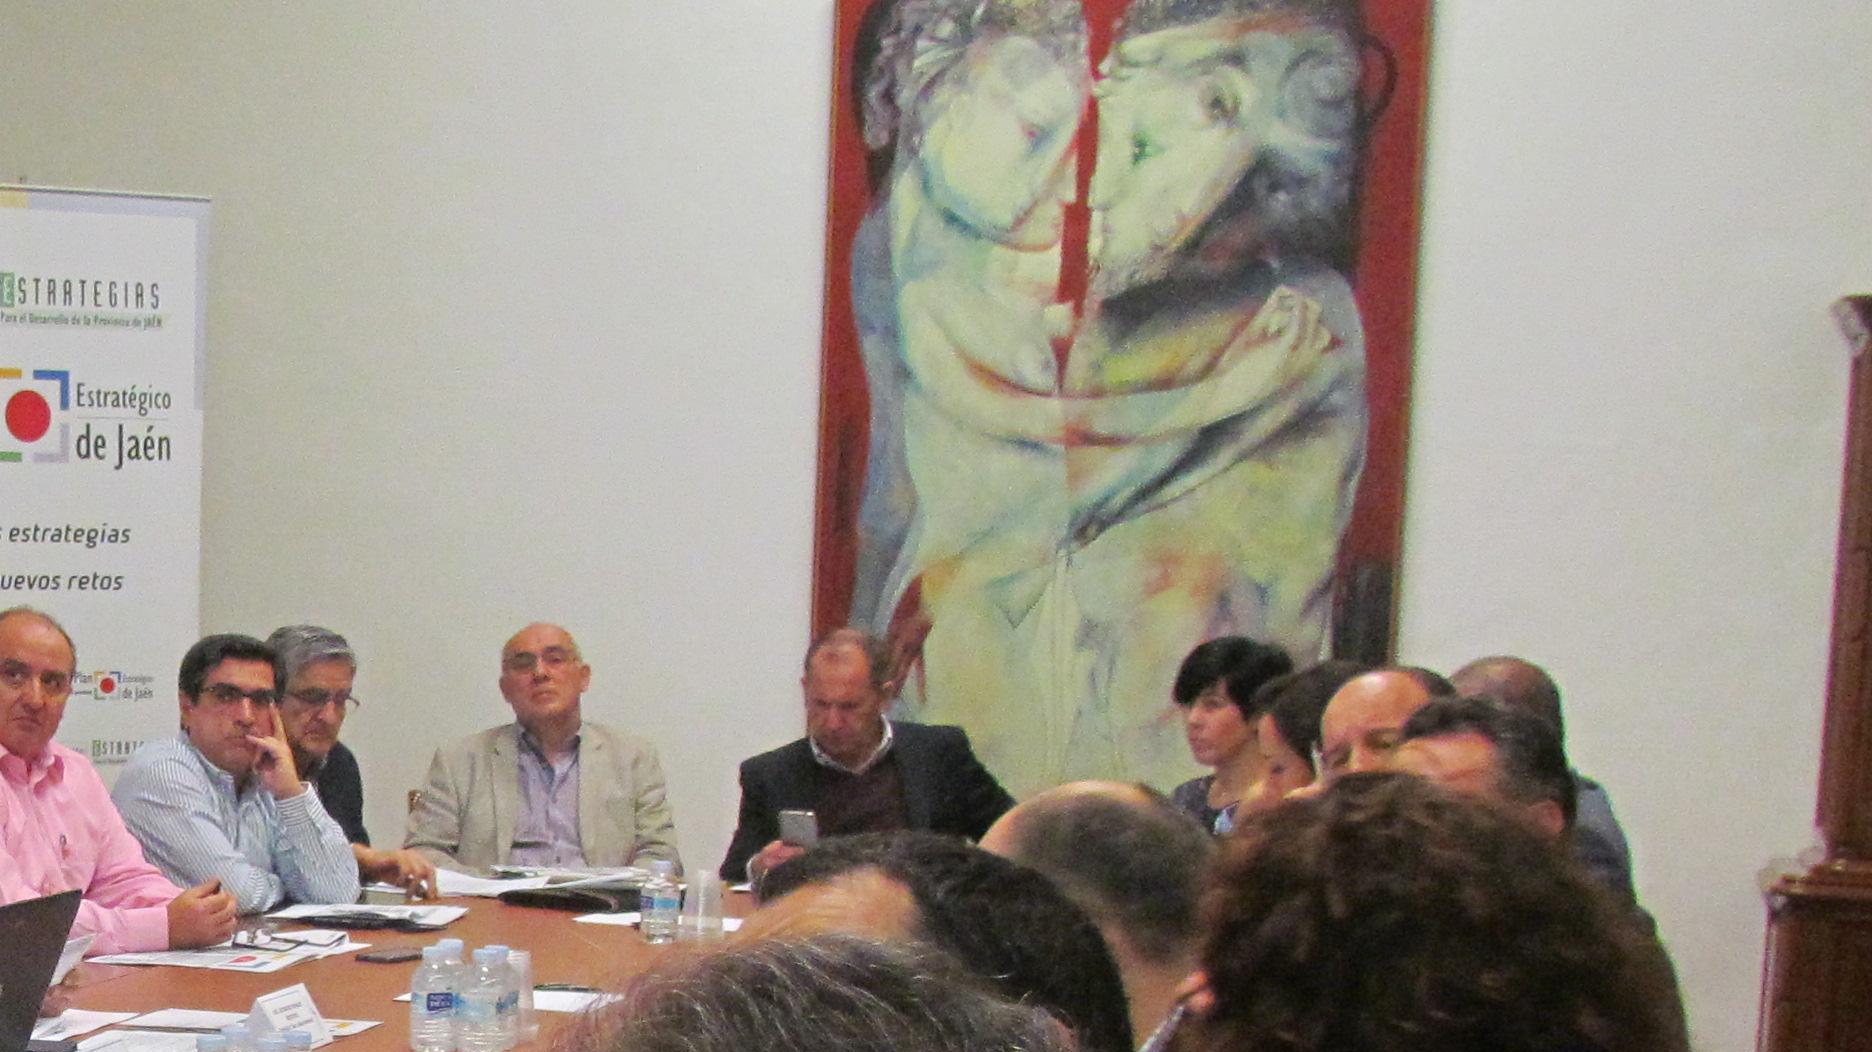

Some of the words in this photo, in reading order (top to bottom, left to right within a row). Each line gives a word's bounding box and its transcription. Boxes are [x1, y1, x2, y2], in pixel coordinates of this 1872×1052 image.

[1, 273, 160, 310] ESTRATEGIAS
[76, 382, 172, 417] Estratégico
[76, 423, 107, 461] de
[114, 423, 172, 470] Jaén
[8, 523, 131, 548] estrategias
[68, 573, 124, 591] retos
